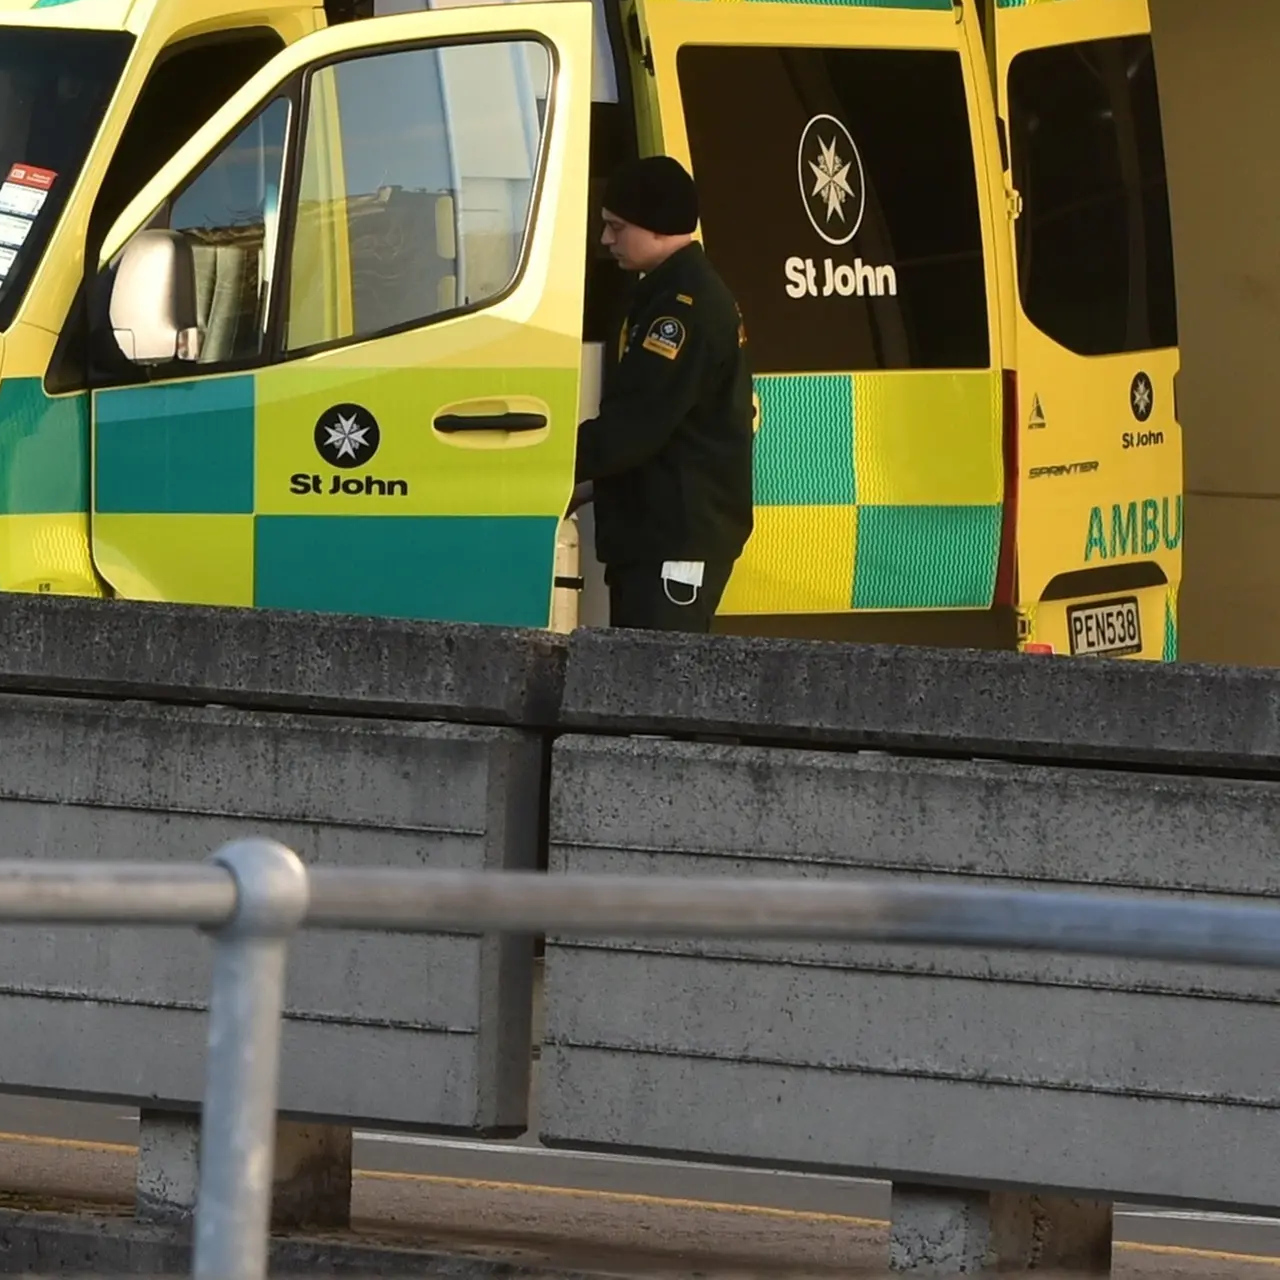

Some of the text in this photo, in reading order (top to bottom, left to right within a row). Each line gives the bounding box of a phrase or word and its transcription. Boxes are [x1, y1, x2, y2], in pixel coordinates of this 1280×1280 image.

[784, 256, 898, 299] St John
[1121, 429, 1164, 450] St John
[289, 473, 409, 496] St John
[1027, 459, 1100, 480] SPRINTER
[1083, 494, 1183, 563] AMBU
[1072, 608, 1137, 650] PEN538
